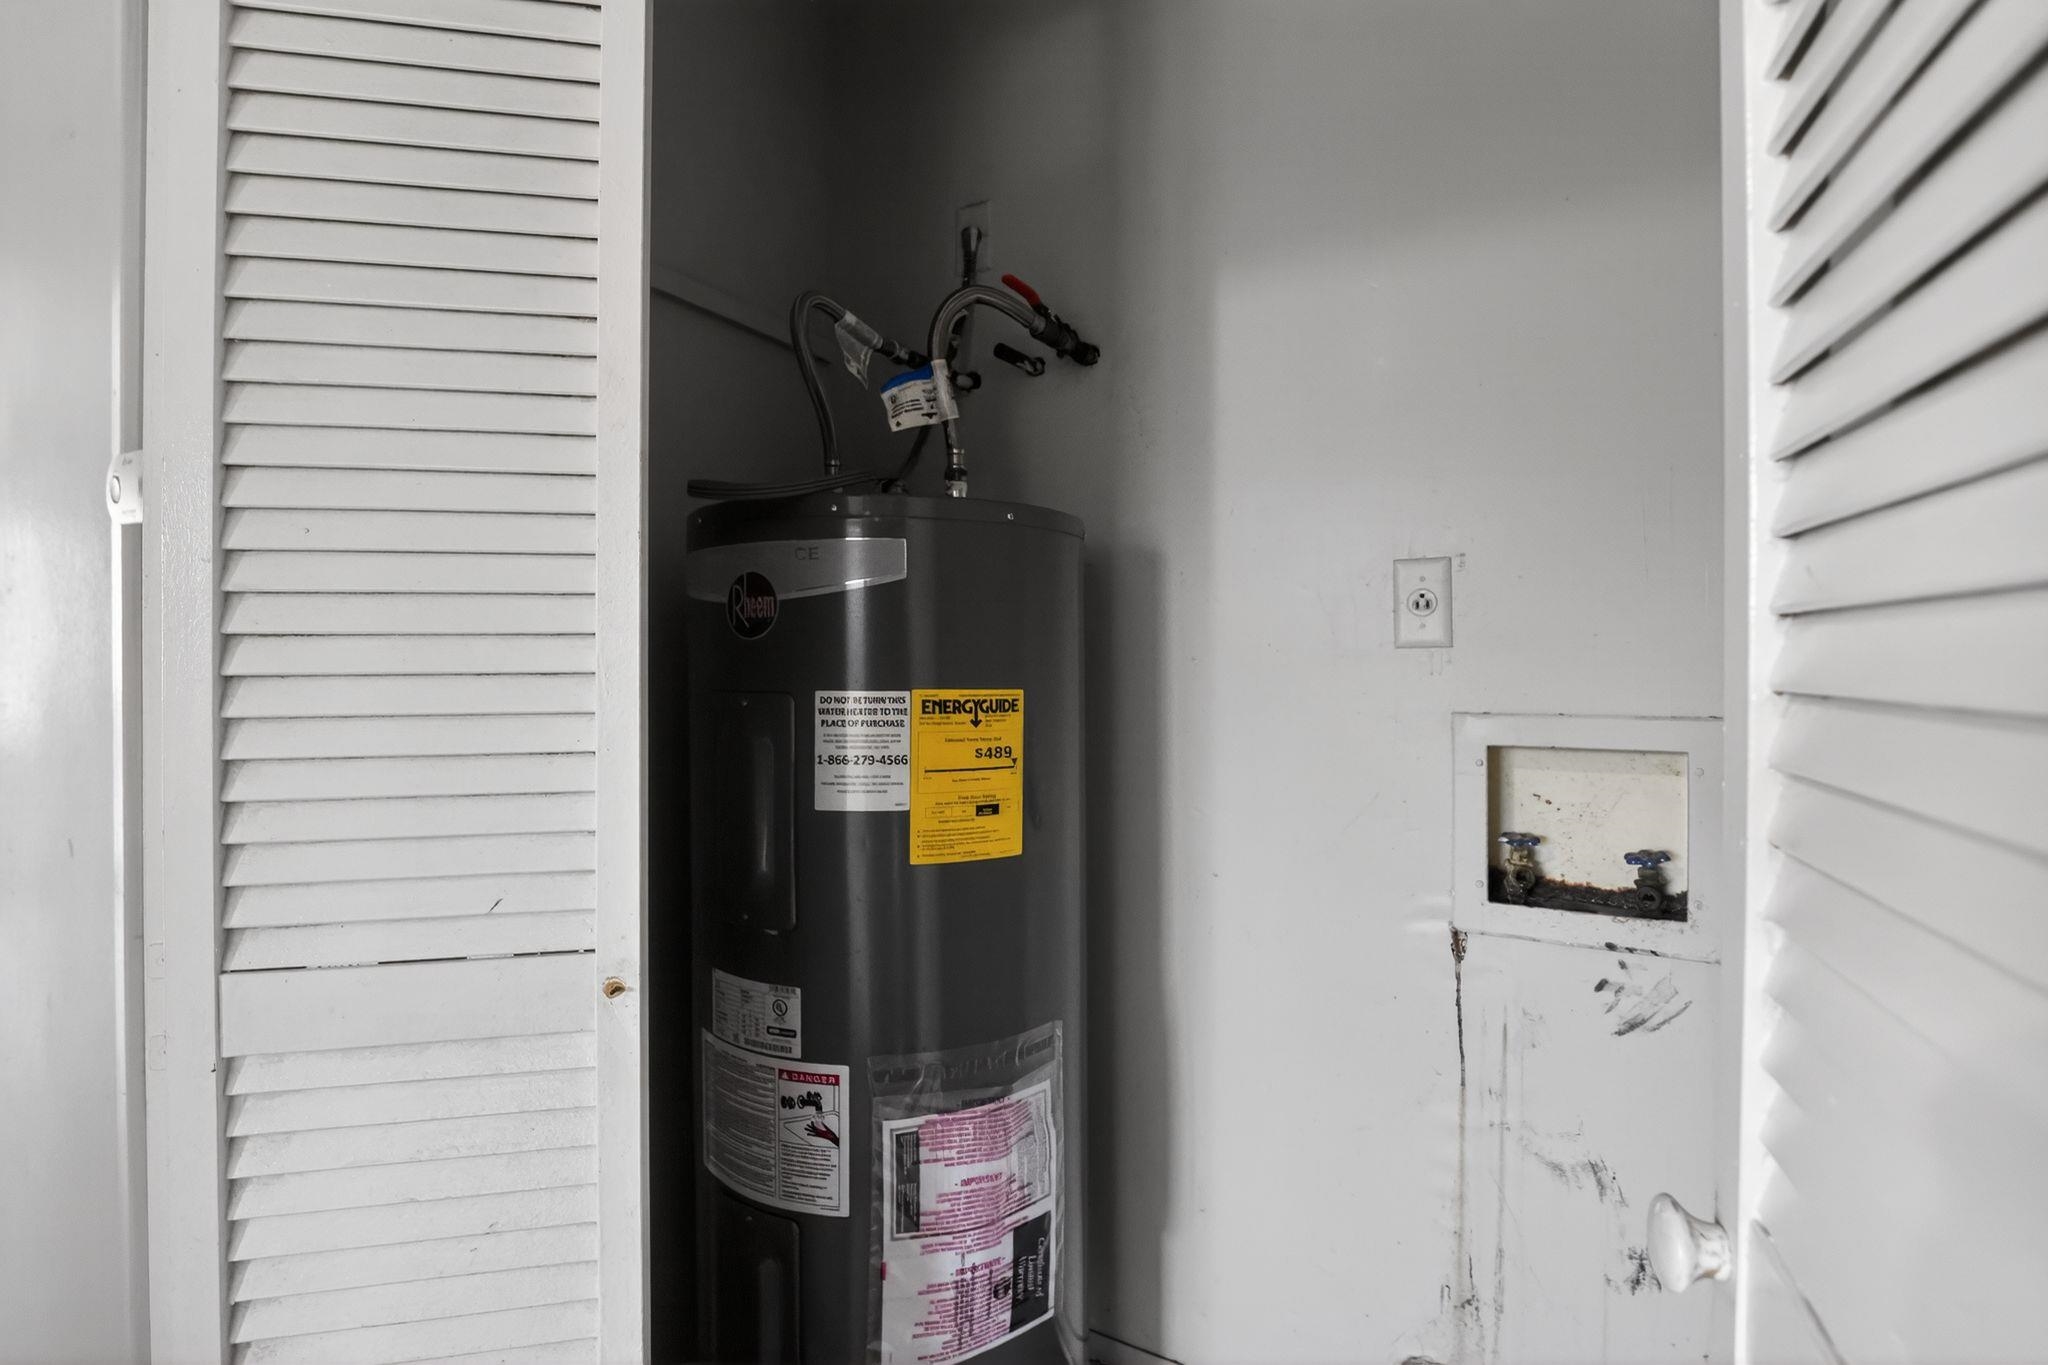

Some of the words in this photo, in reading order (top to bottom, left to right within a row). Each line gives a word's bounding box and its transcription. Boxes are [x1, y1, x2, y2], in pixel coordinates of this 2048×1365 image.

[732, 573, 775, 629] Rheem
[819, 696, 832, 704] DO
[833, 696, 850, 704] NOT
[887, 696, 906, 704] THIS
[818, 707, 846, 716] WATER
[880, 707, 891, 716] TO
[891, 707, 908, 716] THE
[921, 698, 1020, 715] ENERGYGUIDE
[820, 719, 846, 727] PLACE
[847, 719, 858, 727] OF
[860, 719, 906, 727] PURCHASE
[817, 754, 908, 765] 1-866-279-4566
[791, 1073, 836, 1084] DANGER
